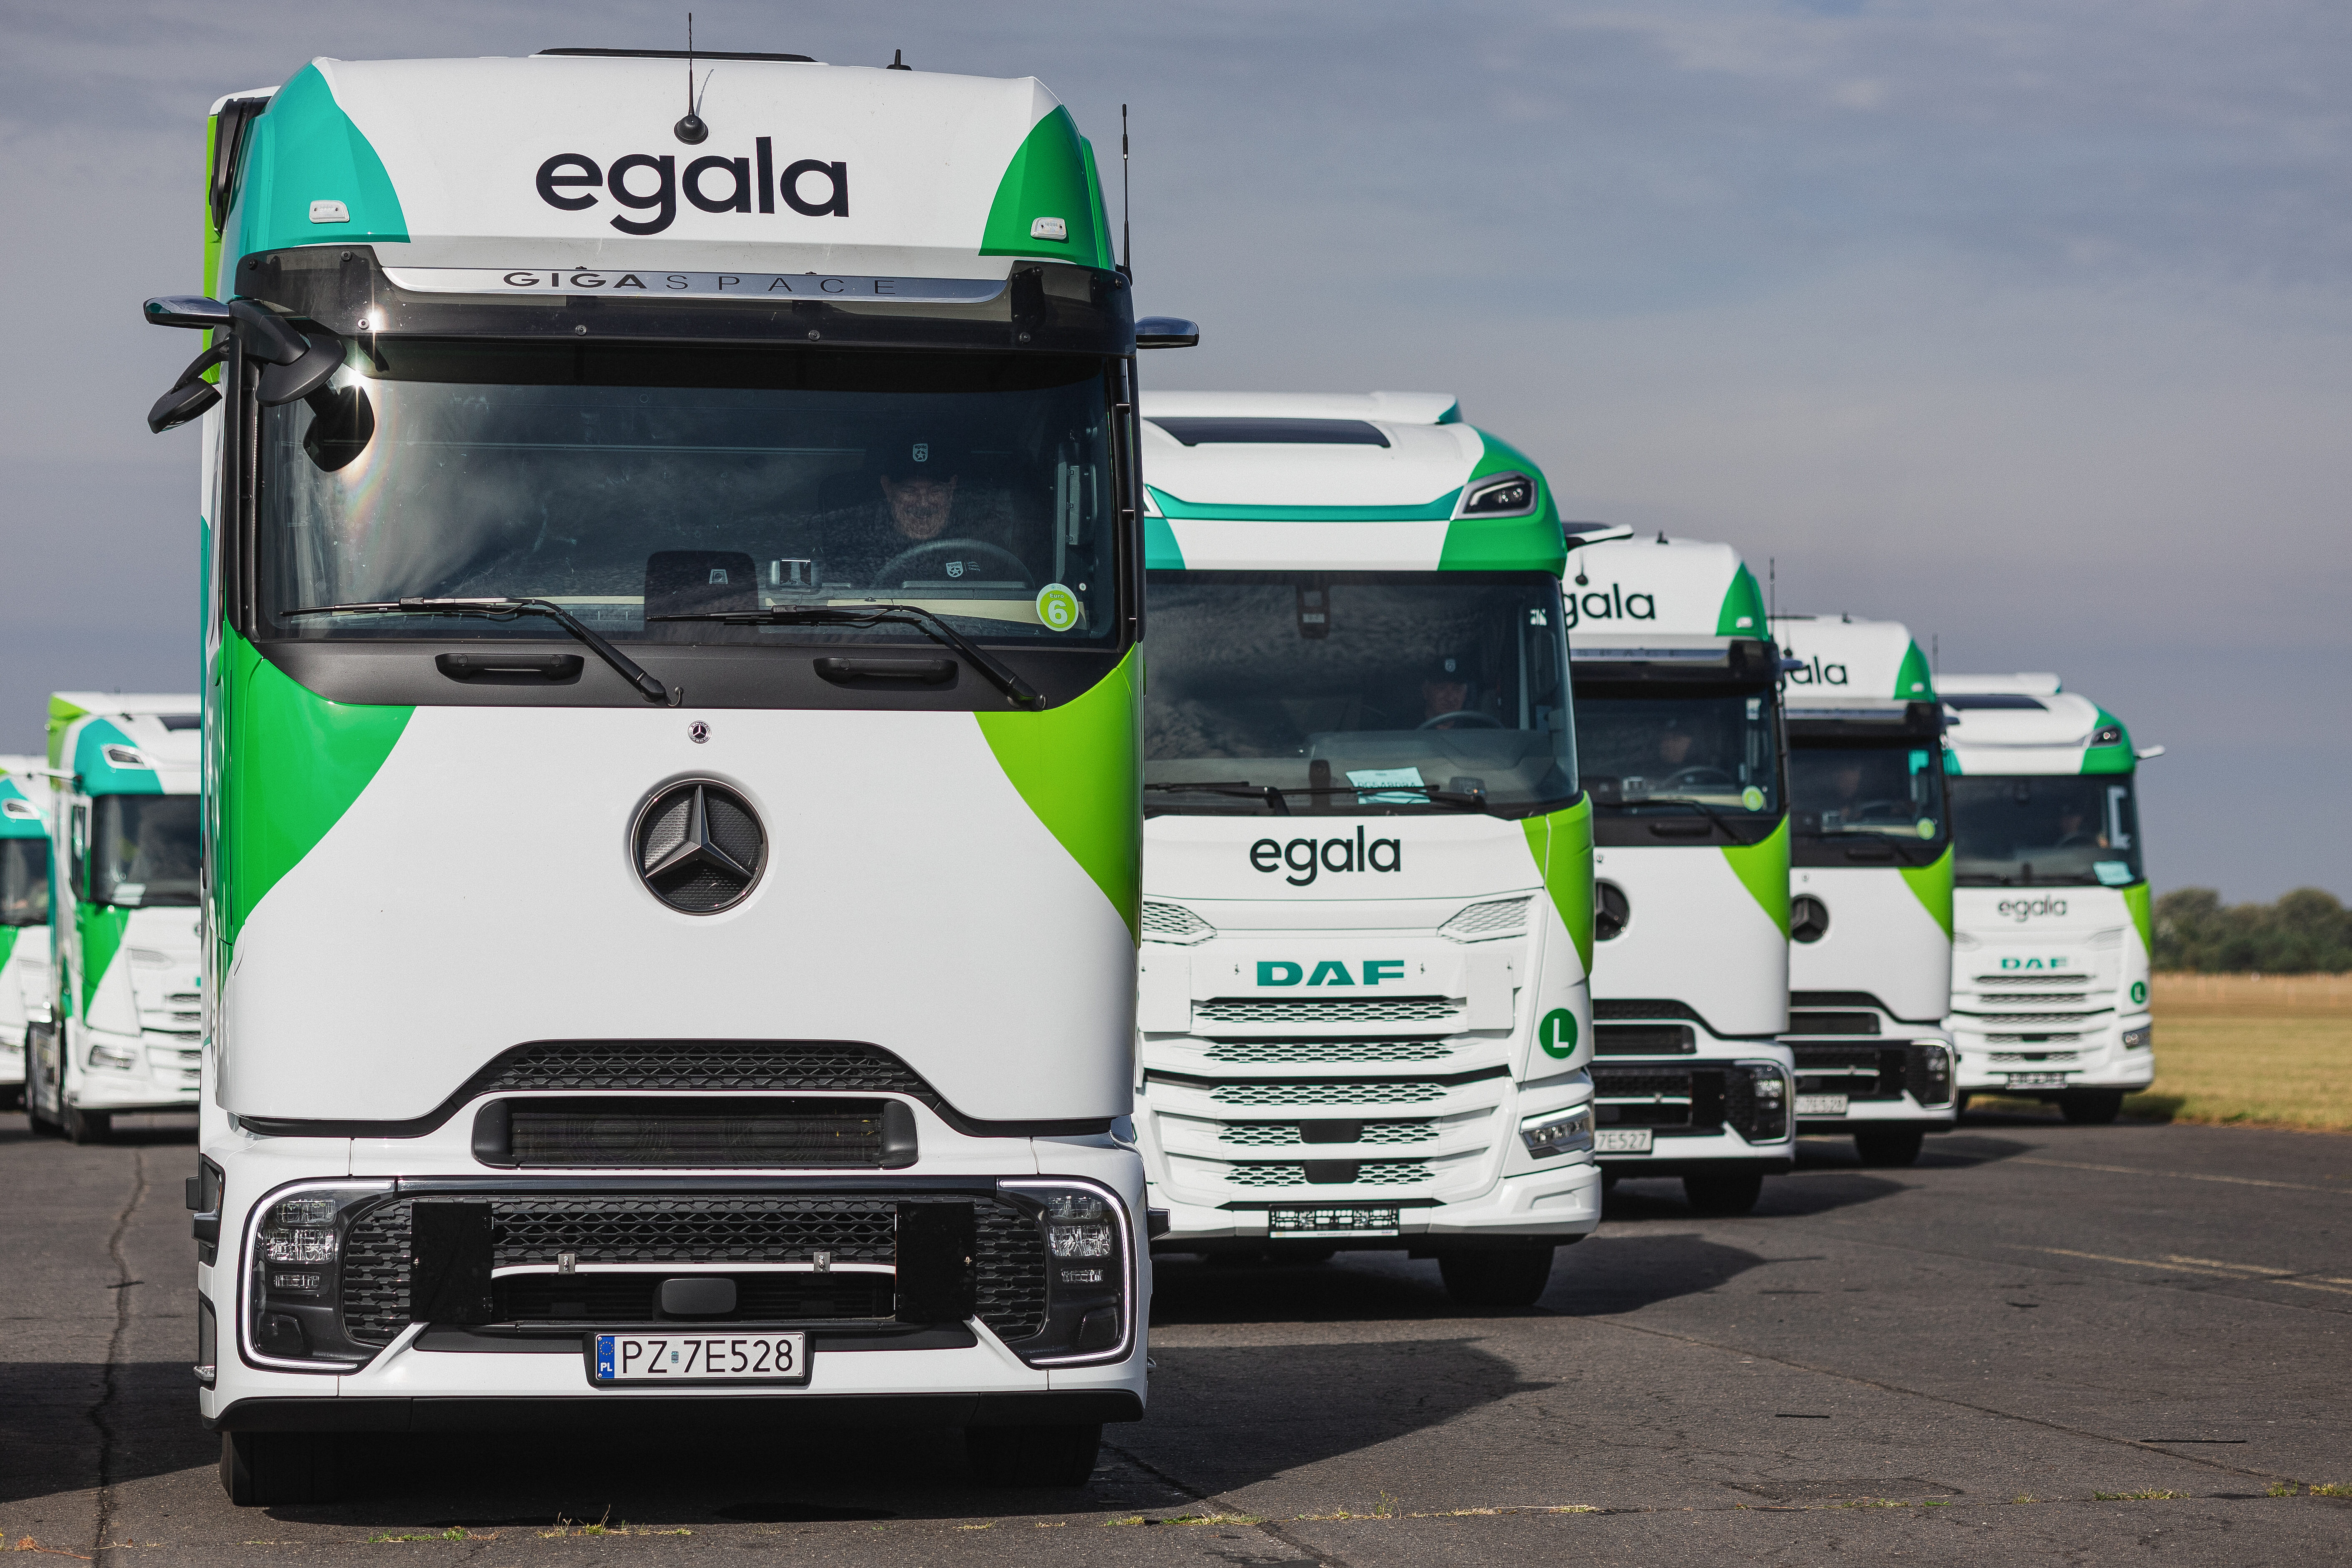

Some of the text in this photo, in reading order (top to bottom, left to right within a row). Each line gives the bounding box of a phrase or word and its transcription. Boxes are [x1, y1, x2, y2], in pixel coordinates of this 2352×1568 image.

[536, 136, 849, 235] egala
[1048, 600, 1068, 625] 6
[1250, 825, 1401, 886] egala
[1998, 895, 2067, 923] egala
[1257, 960, 1404, 986] DAF
[2001, 957, 2068, 970] DAF
[1553, 1018, 1569, 1049] L
[1598, 1133, 1647, 1149] 7E527
[600, 1362, 613, 1372] PL
[622, 1340, 793, 1374] PZ 7E528
